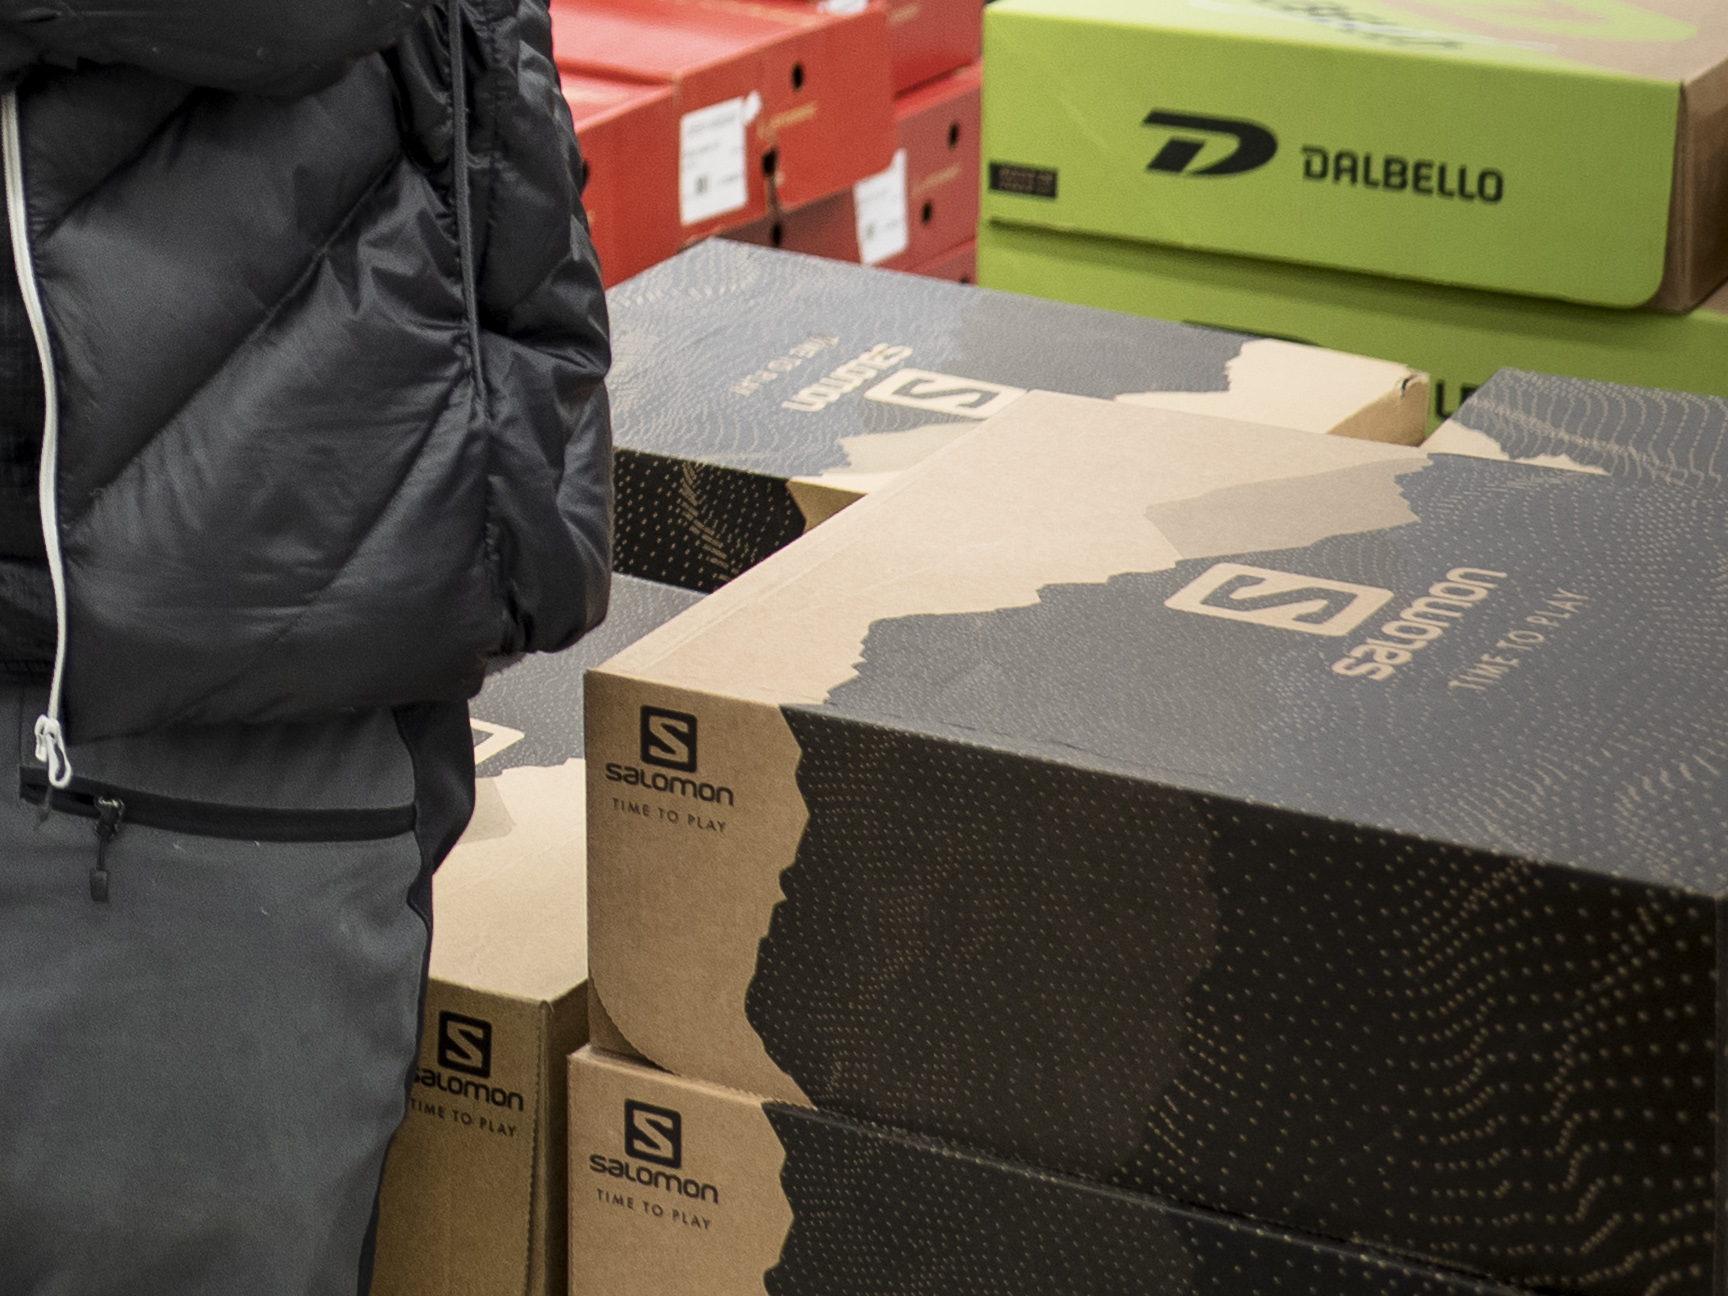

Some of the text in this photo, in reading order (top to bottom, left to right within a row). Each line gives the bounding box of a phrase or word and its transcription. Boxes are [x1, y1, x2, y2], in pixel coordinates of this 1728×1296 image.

[1301, 144, 1506, 205] DALBELLO
[1448, 588, 1590, 691] TIME TO PLAY
[612, 797, 726, 833] TIME TO PLAY
[410, 1098, 516, 1137] TIME TO PLAY
[597, 1188, 711, 1231] TIME TO PLAY
